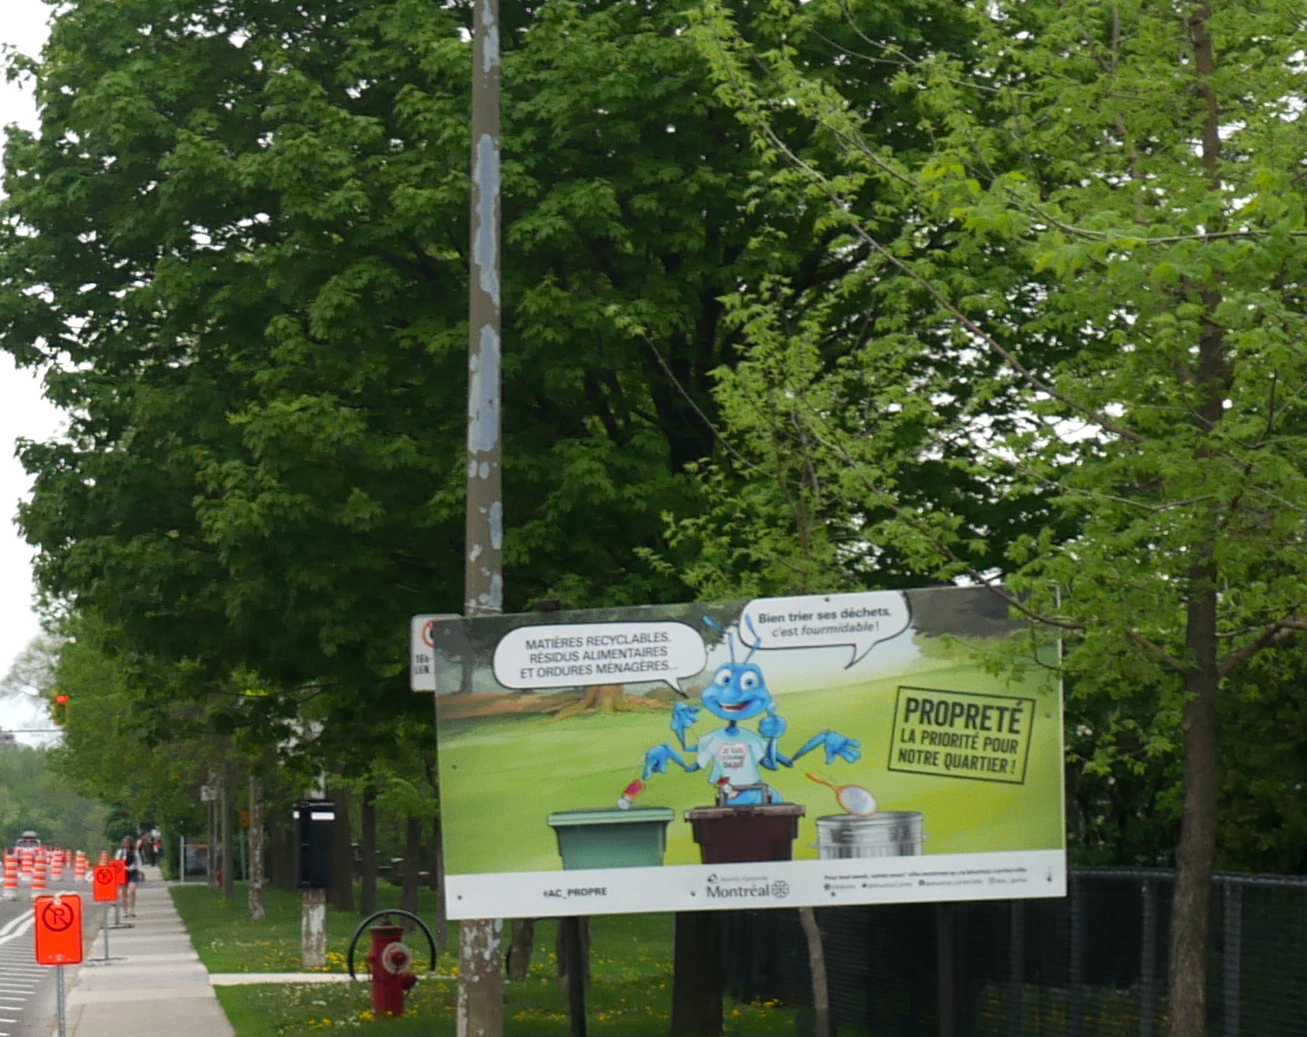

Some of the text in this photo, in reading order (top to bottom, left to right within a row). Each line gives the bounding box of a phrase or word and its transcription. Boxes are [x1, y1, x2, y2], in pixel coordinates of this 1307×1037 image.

[758, 613, 785, 623] Bien
[789, 611, 813, 622] trier
[817, 611, 837, 620] ses
[772, 626, 798, 637] c'est
[526, 635, 583, 650] MATIÈRES
[530, 646, 668, 664] RÉSIDUS ALIMENTAIRES
[520, 668, 533, 679] ET
[537, 664, 593, 678] ORDURES
[904, 697, 1023, 734] PROPRETÉ
[900, 728, 1019, 754] LA PRIORITÉ POUR
[898, 749, 939, 766] NOTRE
[944, 753, 1008, 773] QUARTIER
[706, 883, 769, 900] Montréal
